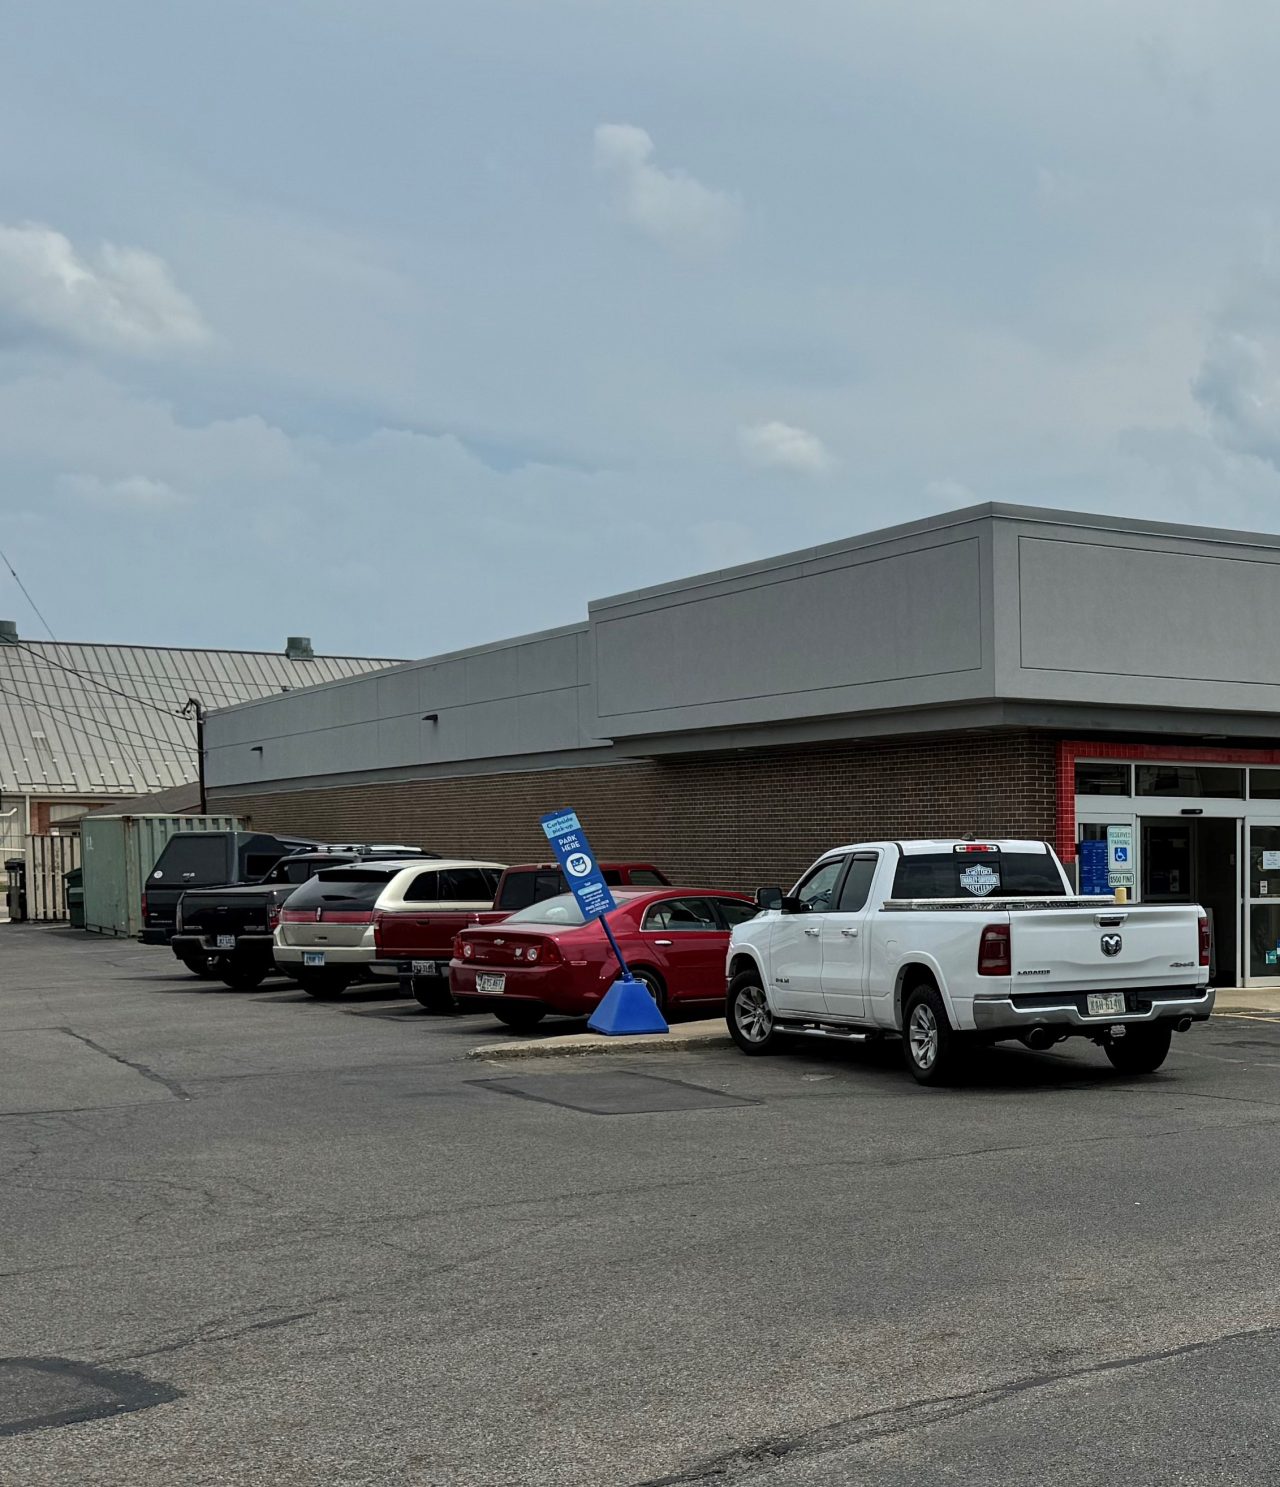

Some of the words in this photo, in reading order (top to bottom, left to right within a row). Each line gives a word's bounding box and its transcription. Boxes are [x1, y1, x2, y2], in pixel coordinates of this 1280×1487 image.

[546, 817, 574, 829] Curbside
[558, 834, 577, 845] PARK
[561, 841, 580, 852] HERE
[1122, 875, 1133, 883] FINE
